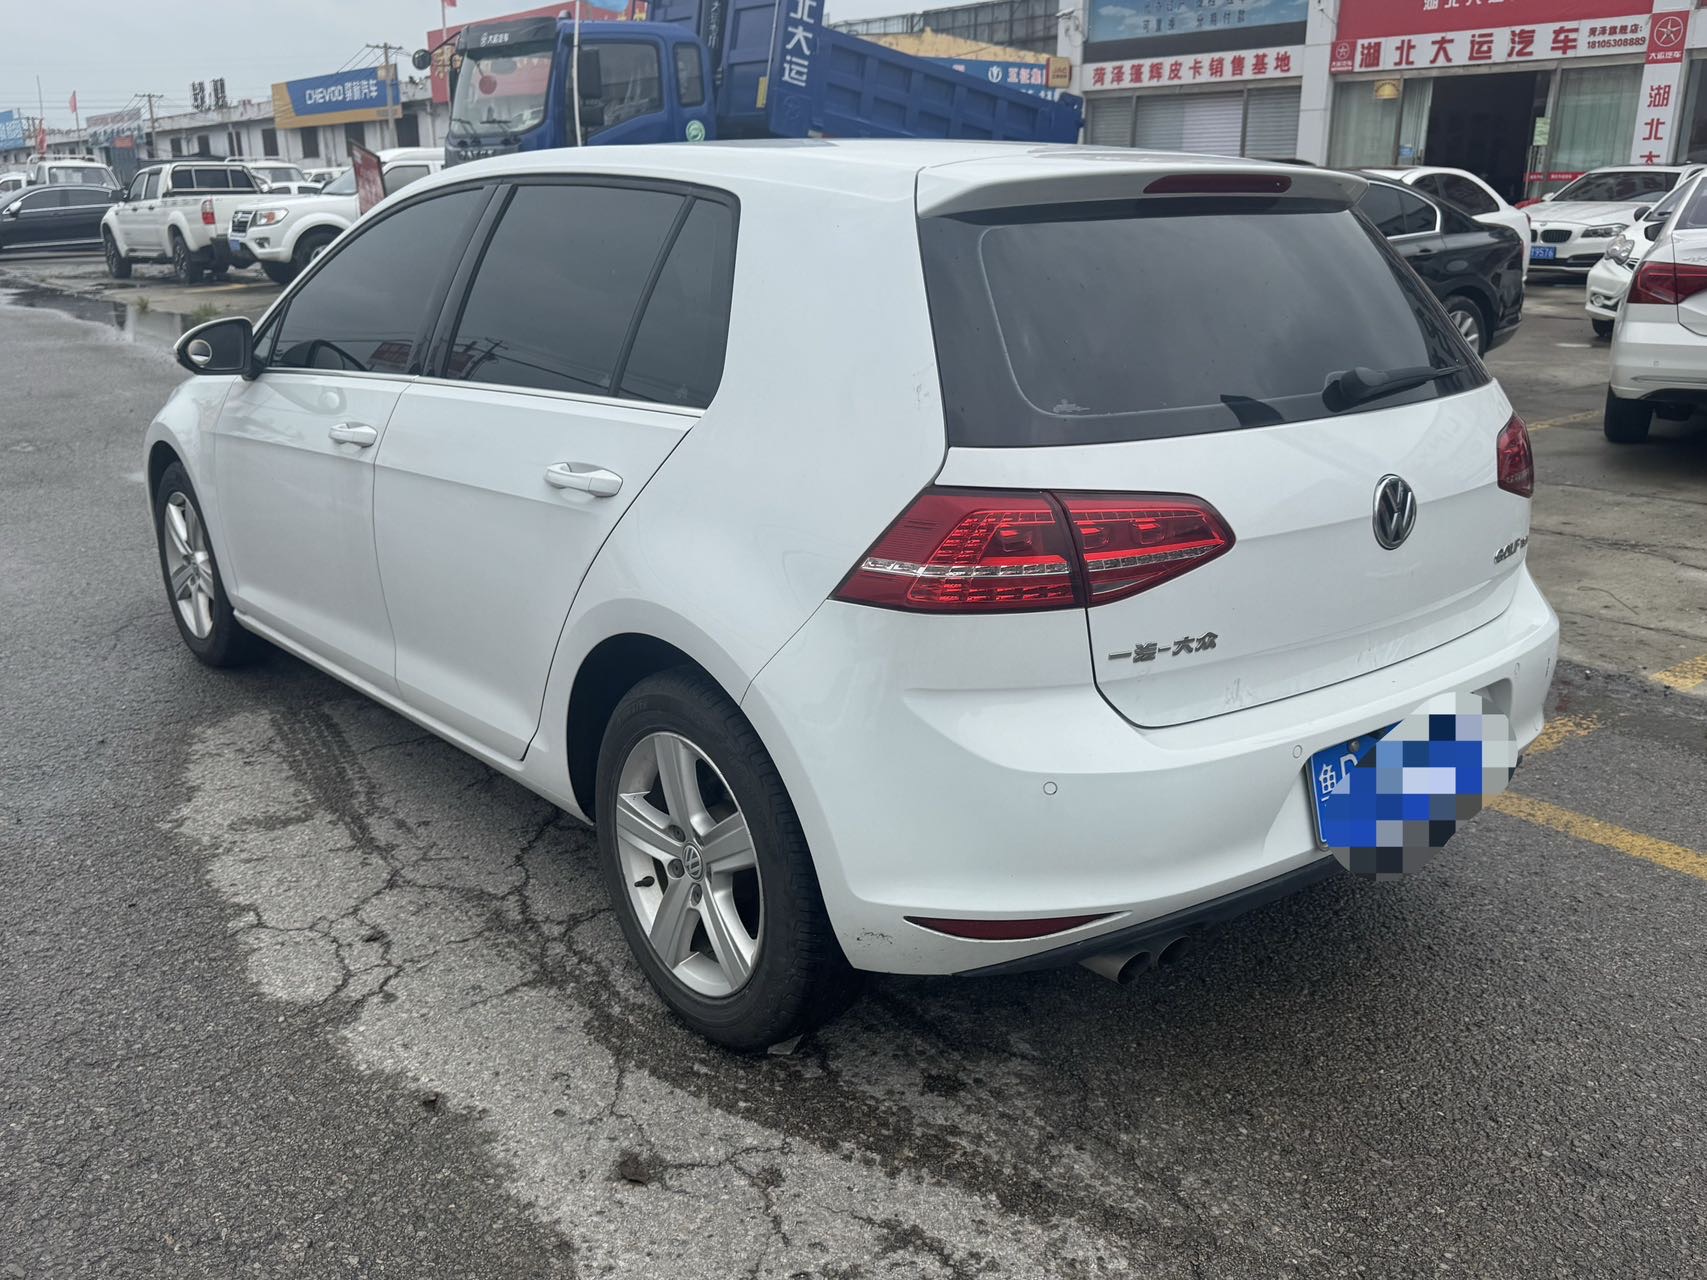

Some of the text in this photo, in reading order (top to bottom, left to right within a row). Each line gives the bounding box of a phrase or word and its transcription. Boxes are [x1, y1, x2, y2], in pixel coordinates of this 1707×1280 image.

[1359, 26, 1579, 68] 湖北大运汽车
[1587, 37, 1646, 49] 18105308889
